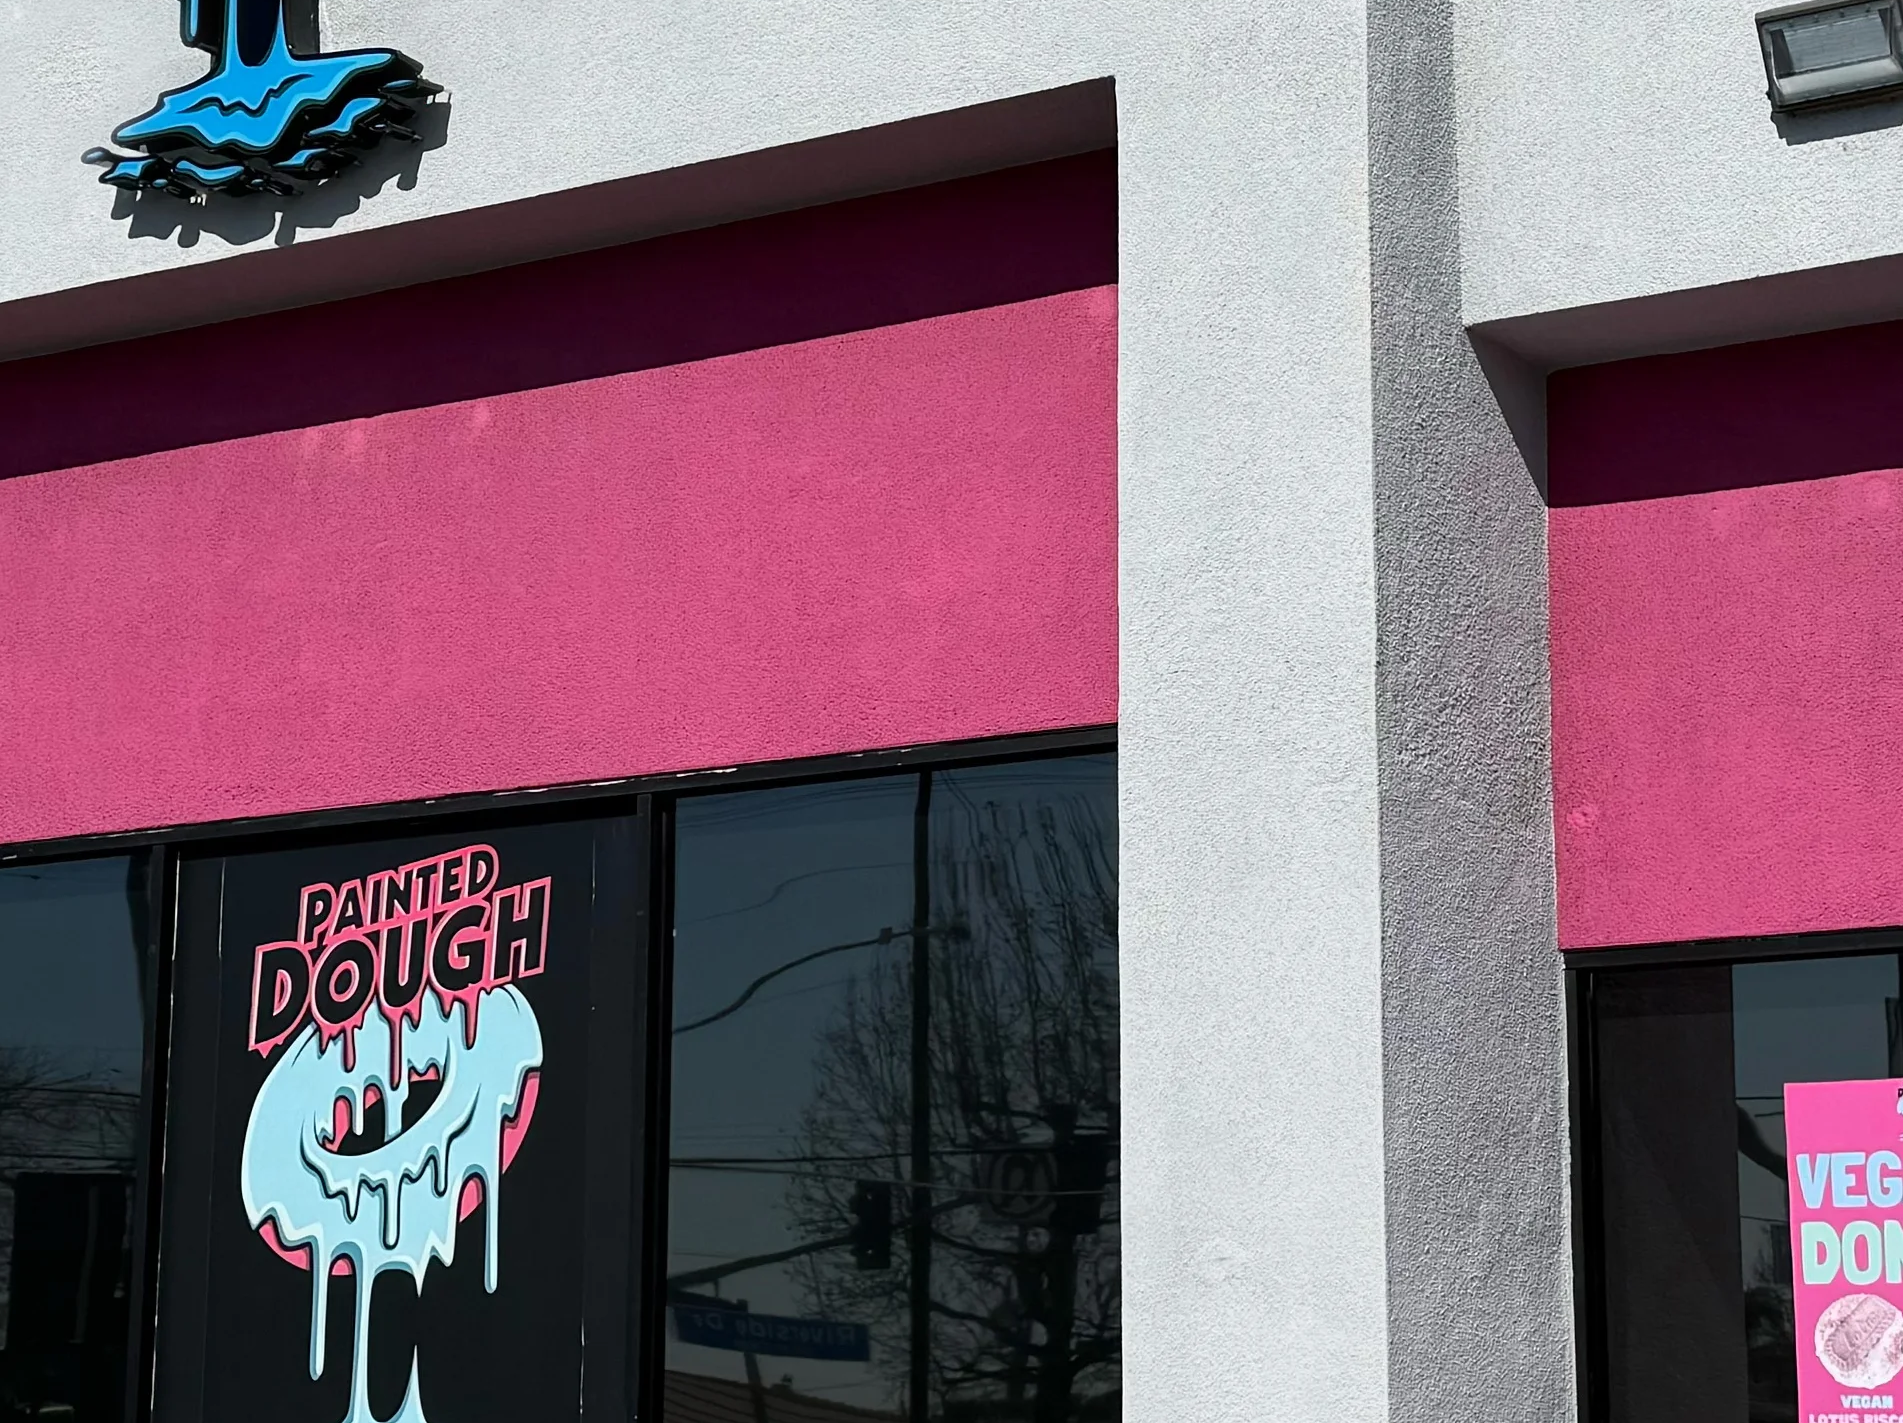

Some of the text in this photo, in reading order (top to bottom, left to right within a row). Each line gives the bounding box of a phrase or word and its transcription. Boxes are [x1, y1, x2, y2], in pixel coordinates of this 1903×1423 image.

[299, 844, 498, 945] PAINTED
[249, 877, 551, 1050] DOUGH
[1840, 1395, 1894, 1409] VEGAN
